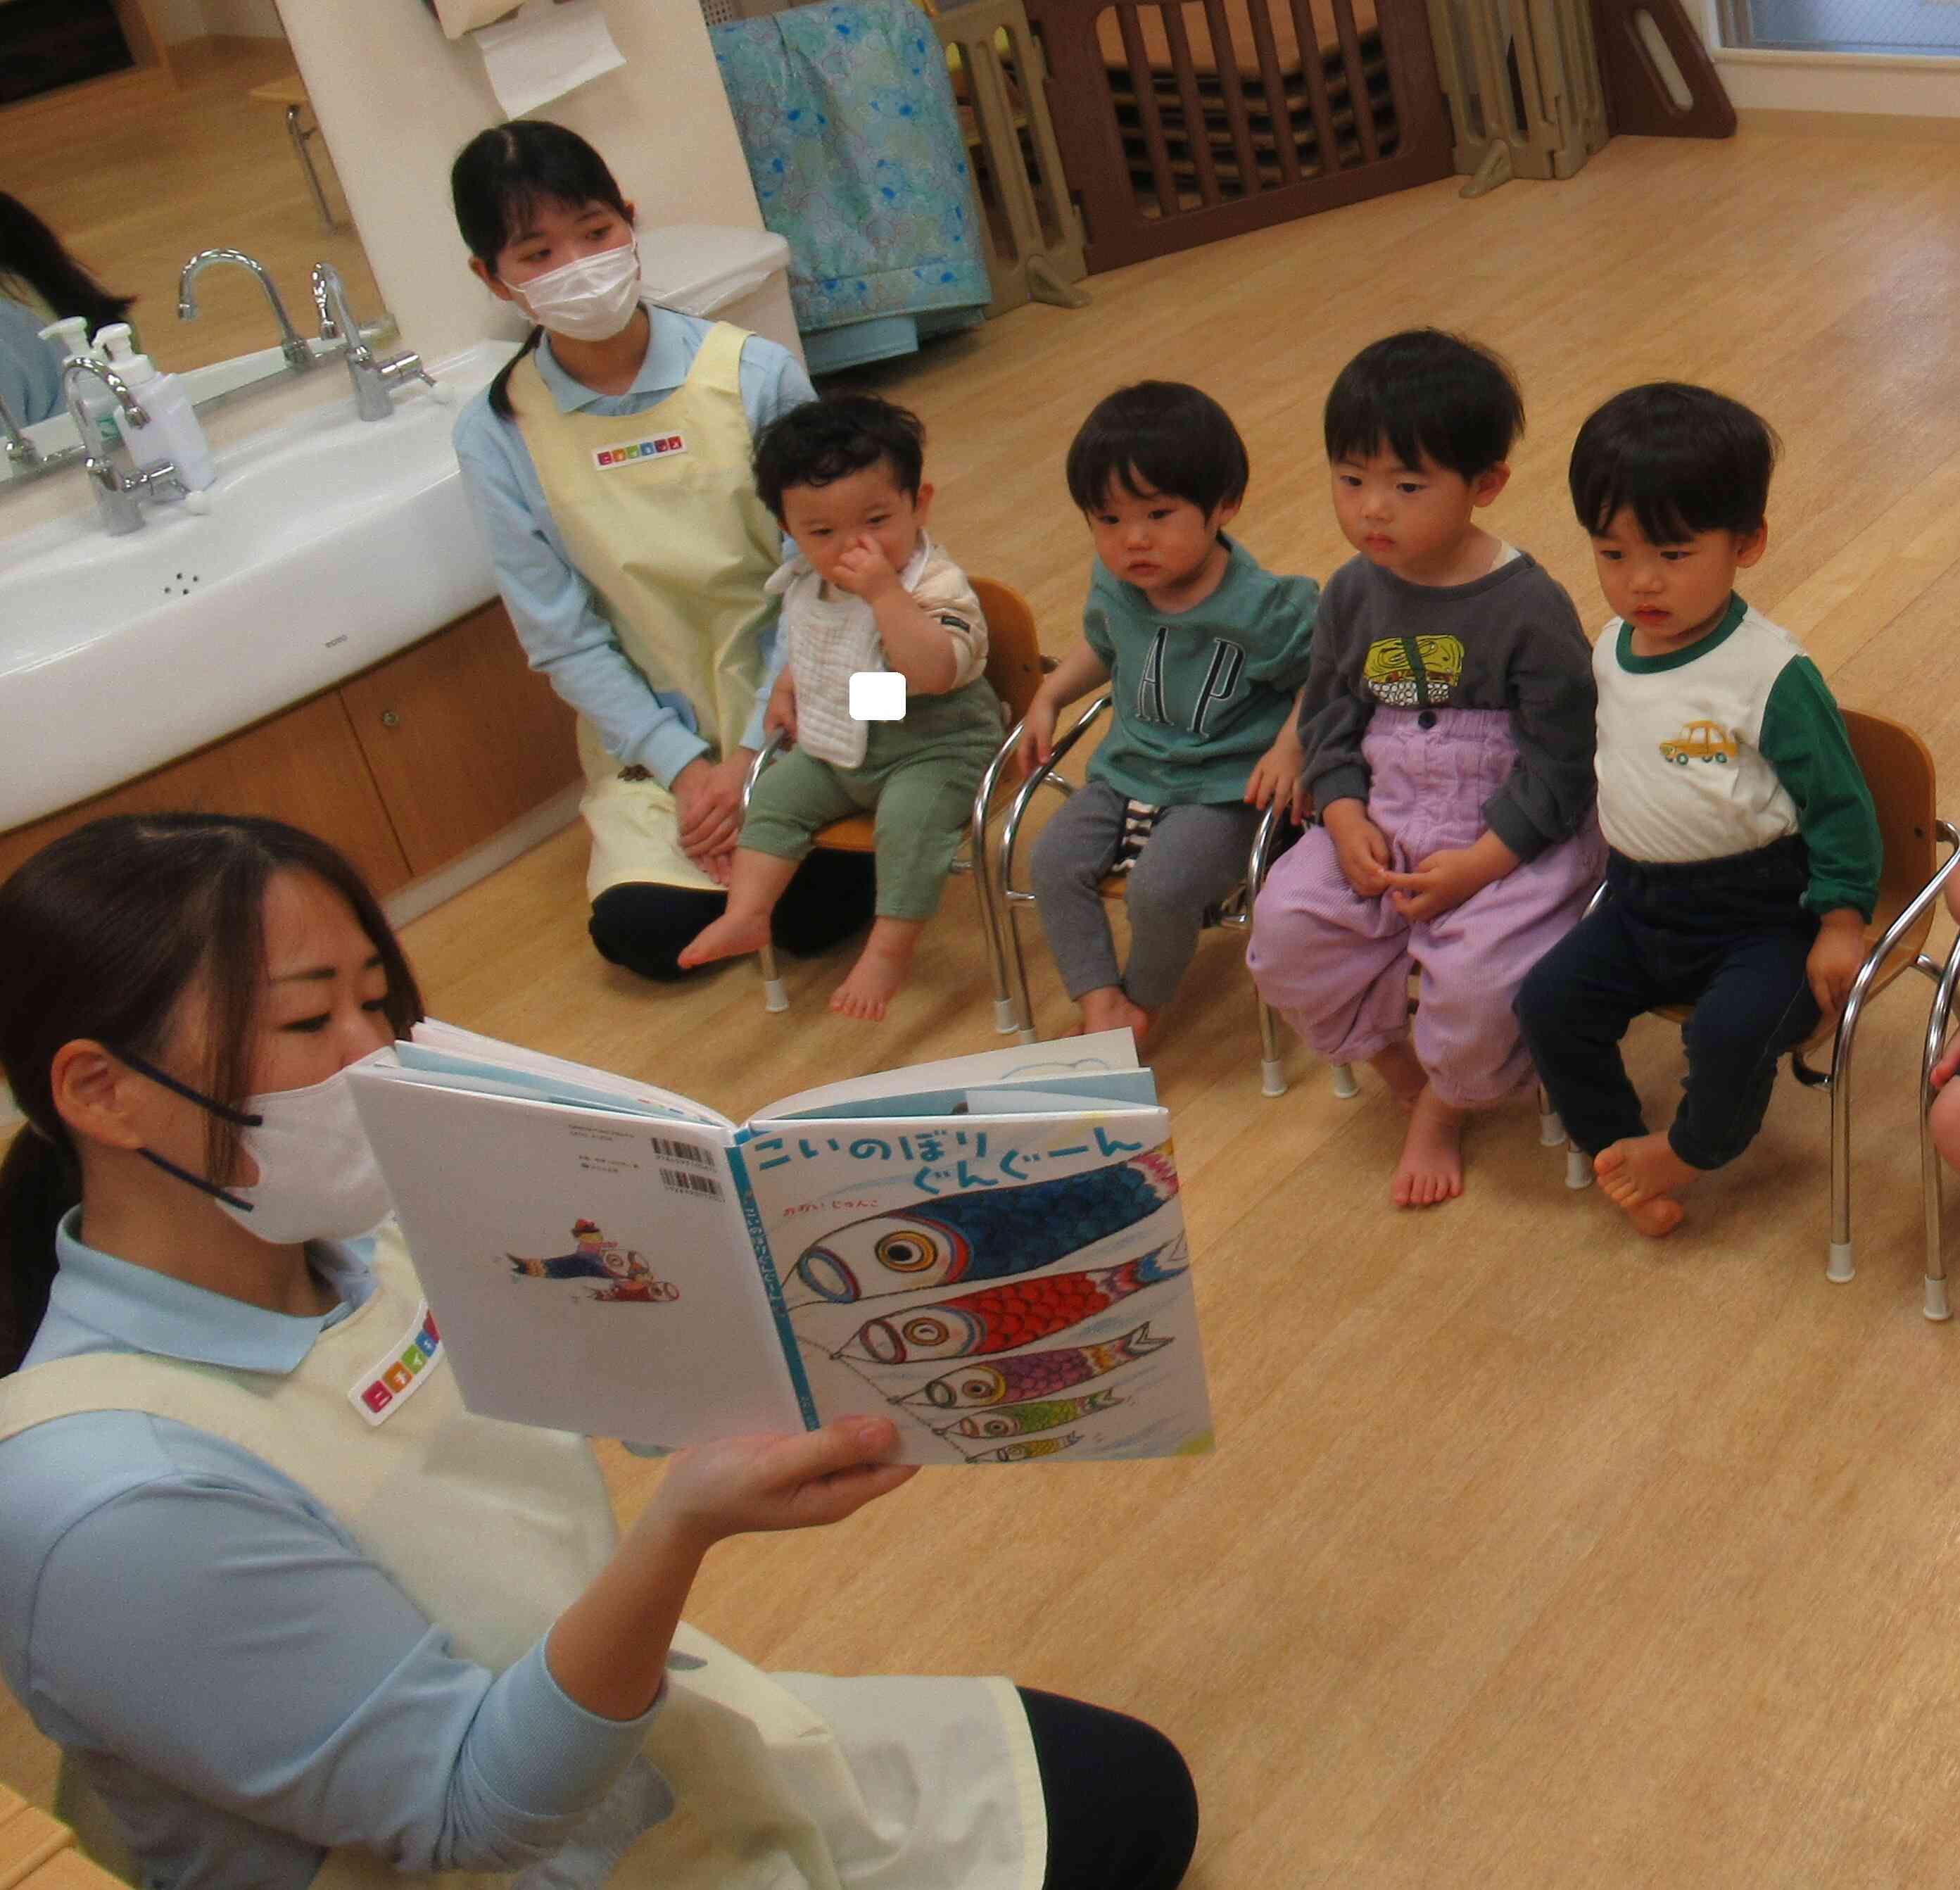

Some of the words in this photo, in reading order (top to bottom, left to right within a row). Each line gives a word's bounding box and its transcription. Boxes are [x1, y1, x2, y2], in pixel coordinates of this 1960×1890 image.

[754, 1129, 987, 1171] こいのぼり
